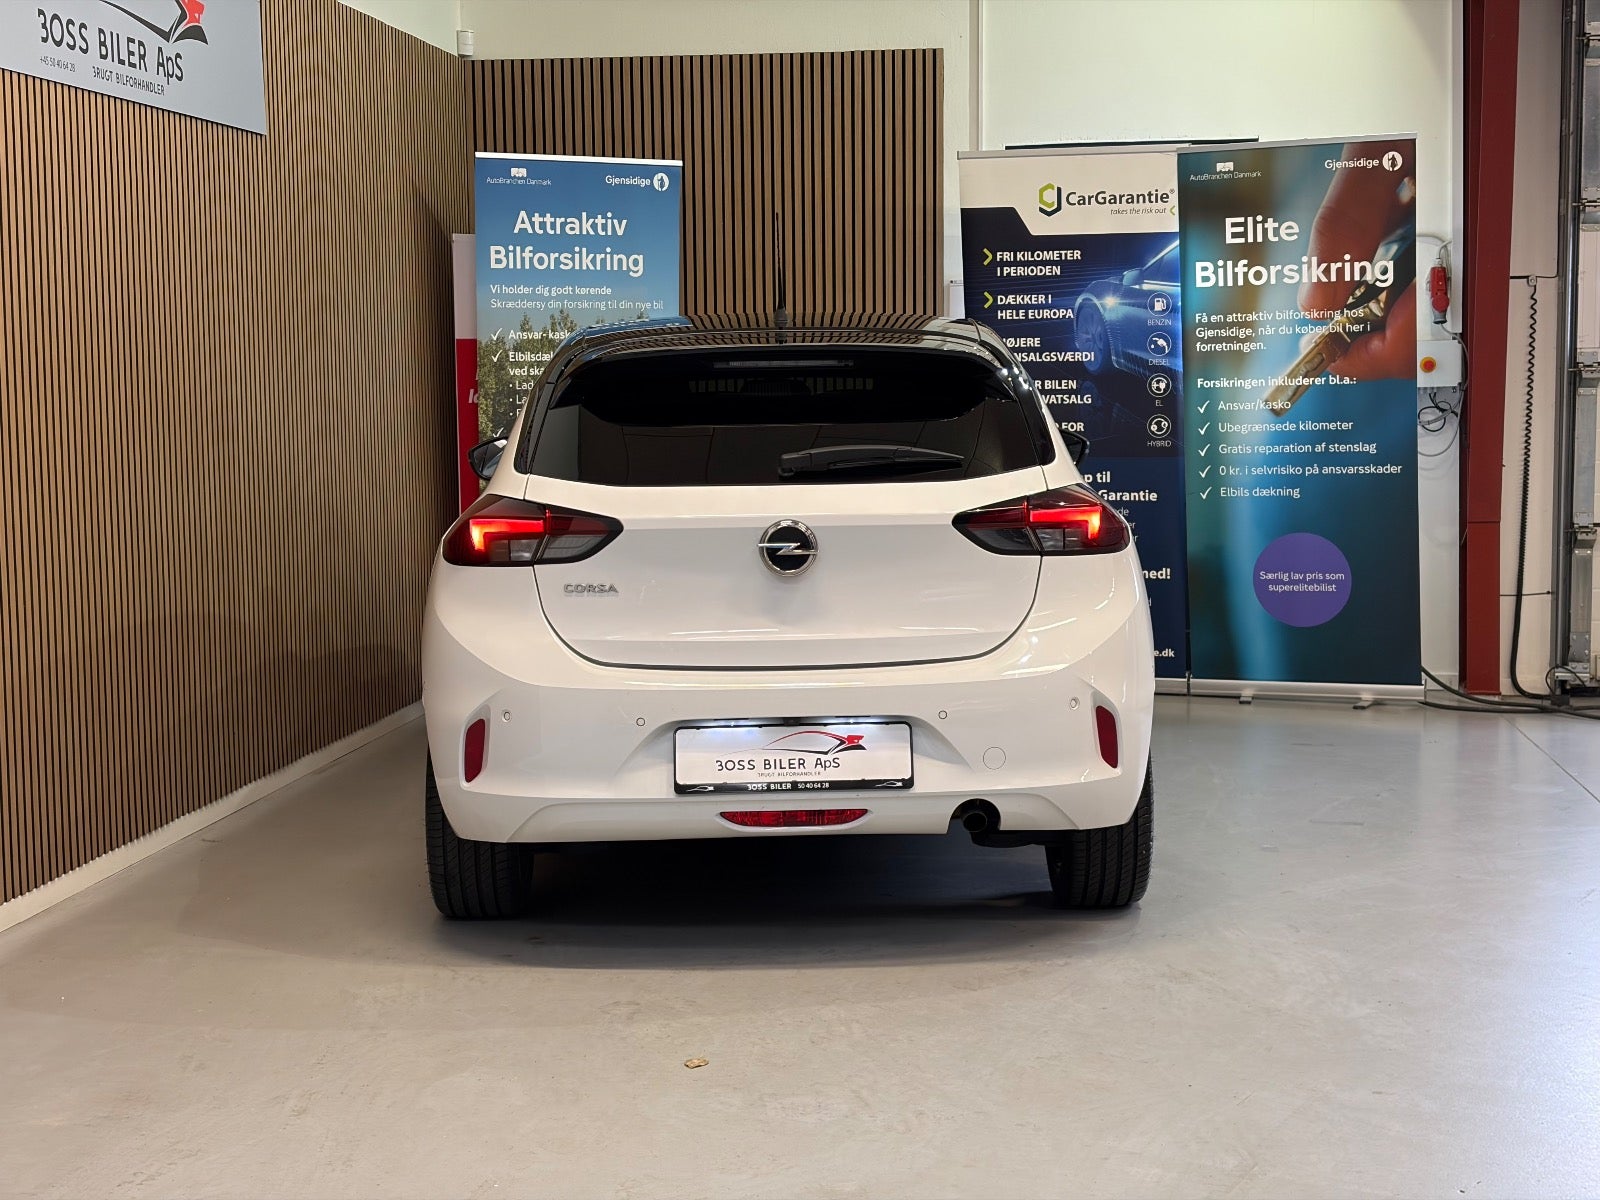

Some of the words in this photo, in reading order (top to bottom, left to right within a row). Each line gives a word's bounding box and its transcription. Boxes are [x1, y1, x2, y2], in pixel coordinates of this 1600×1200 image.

[97, 27, 148, 72] BILER
[156, 46, 184, 85] ApS
[40, 56, 49, 66] +45
[63, 61, 69, 70] 64
[69, 62, 76, 73] 28
[115, 72, 165, 96] BILFORHANDLER
[1324, 158, 1380, 172] Gjensidige
[486, 176, 525, 185] AutoBranchen
[526, 177, 552, 186] Danmark
[605, 174, 651, 188] Gjensidige
[1189, 172, 1233, 182] AutoBranchen
[1234, 170, 1262, 179] Danmark
[1129, 207, 1141, 215] the
[513, 211, 627, 236] Attraktiv
[1225, 215, 1300, 245] Elite
[489, 245, 644, 278] Bilforsikring
[996, 251, 1014, 262] FRI
[1016, 250, 1081, 261] KILOMETER
[997, 267, 1001, 277] I
[1003, 265, 1061, 277] PERIODEN
[1195, 254, 1394, 288] Bilforsikring
[490, 284, 501, 294] Vi
[502, 284, 533, 295] holder
[535, 285, 550, 297] dig
[551, 285, 573, 297] godt
[575, 285, 612, 296] kørende
[490, 299, 545, 311] Skræddersy
[547, 299, 562, 309] din
[563, 299, 606, 311] forsikring
[608, 299, 617, 309] til
[618, 300, 633, 310] din
[635, 302, 651, 312] nye
[653, 300, 664, 310] bil
[997, 294, 1046, 305] DÆKKER
[1048, 294, 1052, 304] I
[997, 310, 1026, 320] HELE
[1028, 309, 1074, 320] EUROPA
[1195, 311, 1208, 323] Få
[1210, 314, 1224, 323] en
[1226, 311, 1273, 322] attraktiv
[1276, 309, 1341, 321] bilforsikring
[1343, 308, 1364, 318] hos
[548, 330, 571, 340] kask
[1195, 326, 1256, 339] Gjensidige,
[1258, 323, 1277, 335] når
[1278, 324, 1293, 335] du
[1295, 323, 1327, 334] køber
[1329, 322, 1343, 333] bil
[1345, 322, 1365, 332] her
[1367, 322, 1371, 332] i
[1003, 337, 1041, 348] ØJERE
[1195, 341, 1267, 353] forretningen.
[1014, 351, 1095, 362] NSALGSVÆRDI
[1148, 358, 1170, 366] DIESEL
[509, 366, 527, 376] ved
[529, 366, 545, 376] ska
[516, 381, 534, 390] Lad
[1034, 380, 1042, 390] R
[1044, 379, 1077, 390] BILEN
[1197, 376, 1266, 389] Forsikringen
[1268, 376, 1327, 387] inkluderer
[1328, 375, 1357, 385] bl.a.:
[1042, 394, 1092, 404] VATSALG
[1218, 399, 1291, 411] Ansvar/kasko
[1061, 422, 1085, 432] FOR
[1218, 422, 1297, 434] Ubegrænsede
[1299, 420, 1353, 431] kilometer
[1218, 443, 1251, 455] Gratis
[1254, 443, 1312, 455] reparation
[1314, 442, 1326, 452] af
[1328, 442, 1377, 454] stenslag
[1219, 465, 1227, 475] 0
[1229, 464, 1242, 475] kr.
[1245, 464, 1249, 475] i
[1251, 464, 1303, 475] selvrisiko
[1305, 464, 1319, 477] på
[1321, 463, 1402, 475] ansvarsskader
[1096, 471, 1111, 483] til
[1098, 489, 1158, 501] Garantie
[1220, 487, 1250, 497] Elbils
[1252, 486, 1300, 499] dækning
[1259, 570, 1289, 582] Særlig
[1290, 571, 1304, 580] lav
[1306, 571, 1323, 582] pris
[1325, 572, 1345, 580] som
[563, 583, 619, 594] CORSA
[1268, 583, 1337, 593] superelitebilist
[1153, 648, 1175, 658] e.dk
[763, 758, 806, 770] BILER
[814, 757, 841, 771] ApS
